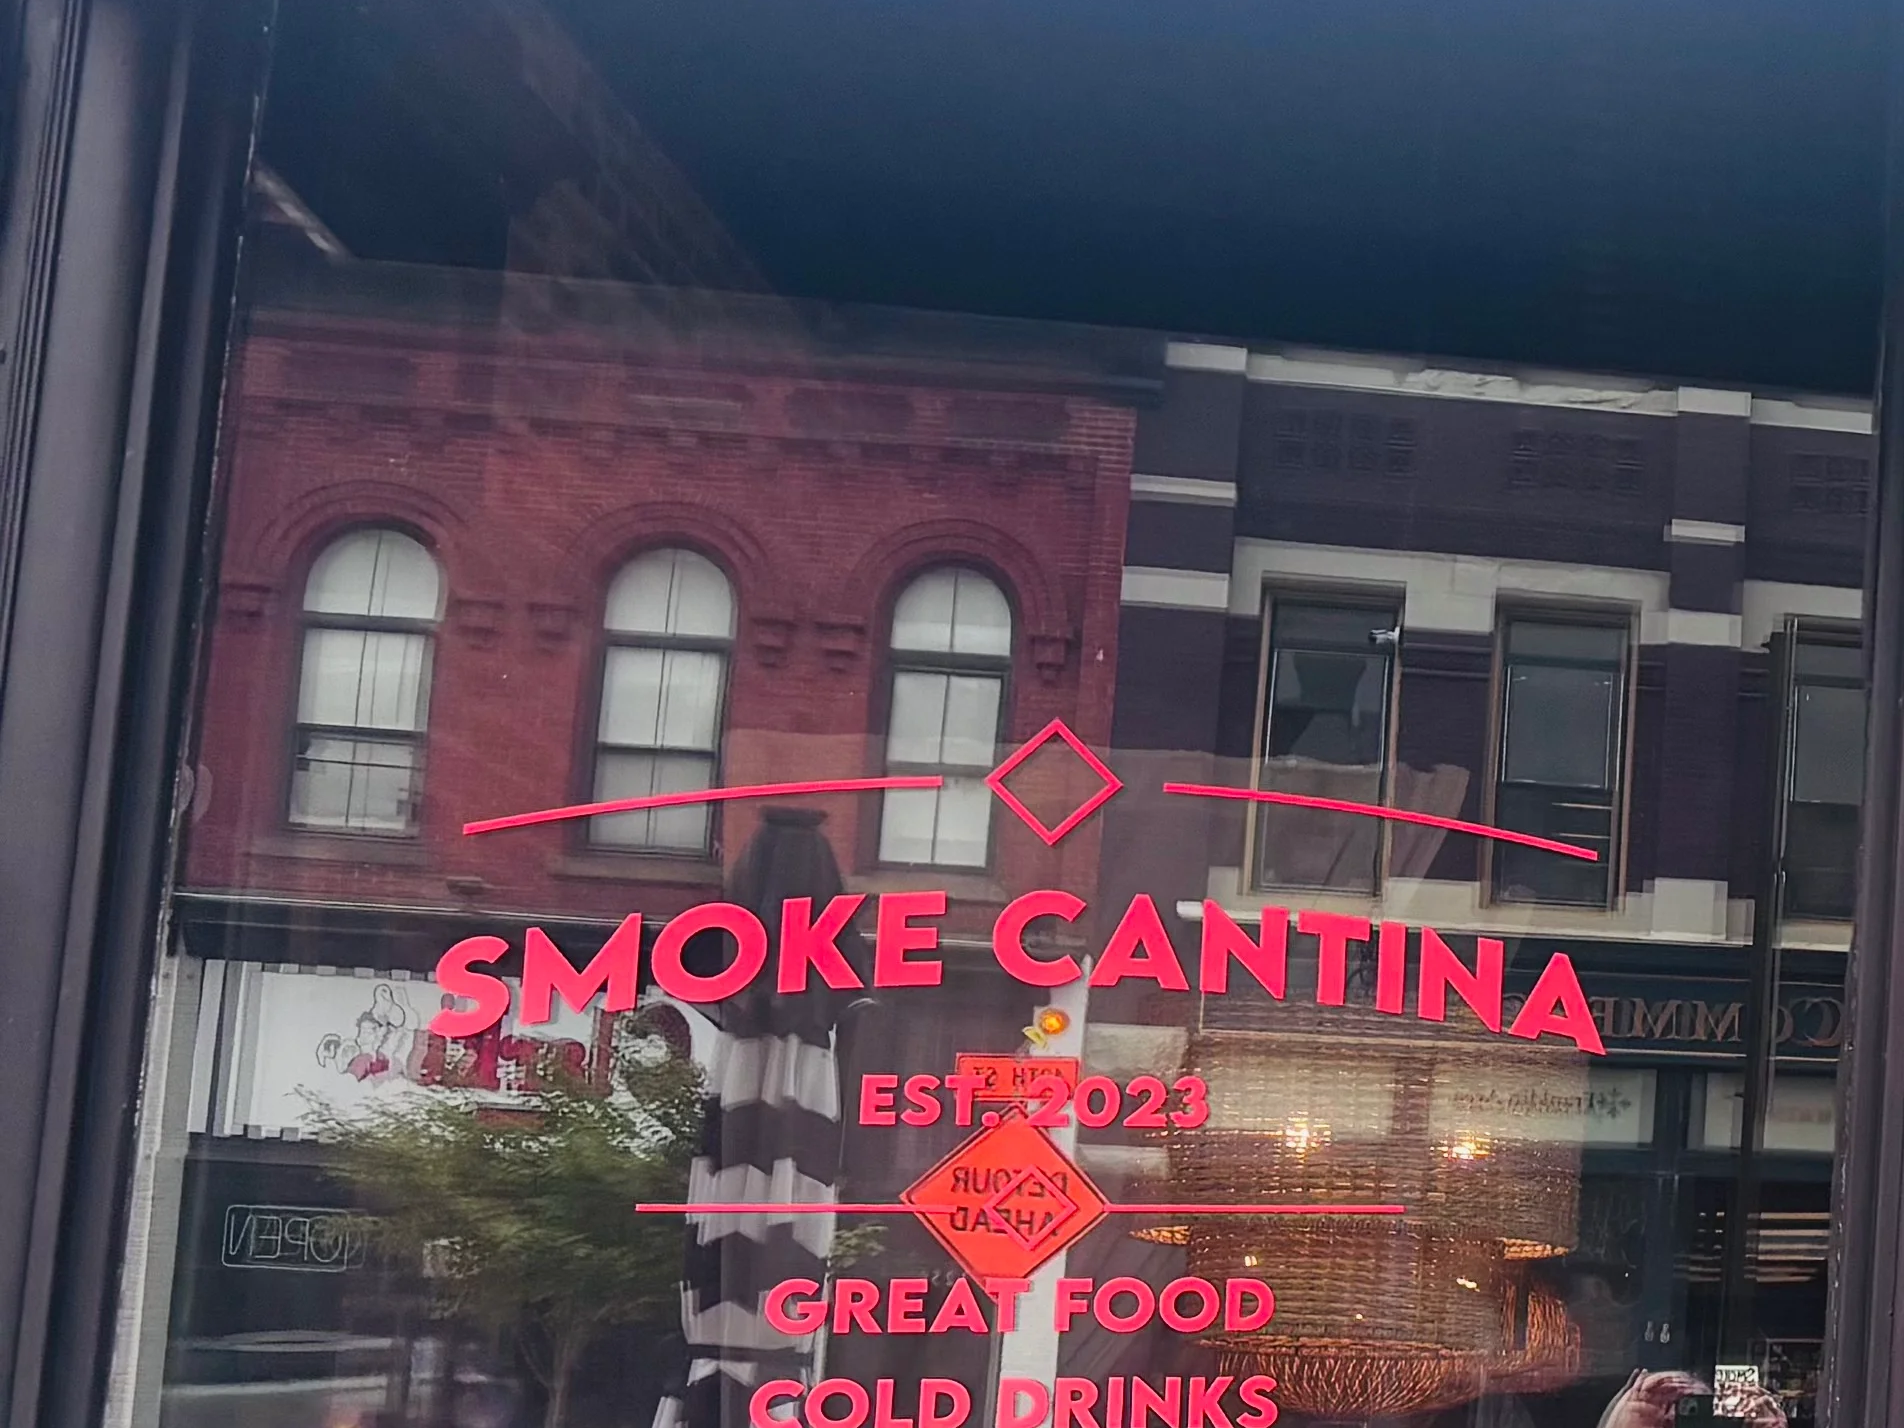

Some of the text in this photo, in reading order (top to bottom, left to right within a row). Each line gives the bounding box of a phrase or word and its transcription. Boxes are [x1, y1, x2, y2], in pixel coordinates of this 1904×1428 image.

[428, 889, 1606, 1056] SMOKE CANTINA
[858, 1073, 1210, 1129] EST. 2023
[763, 1276, 1275, 1335] GREAT FOOD
